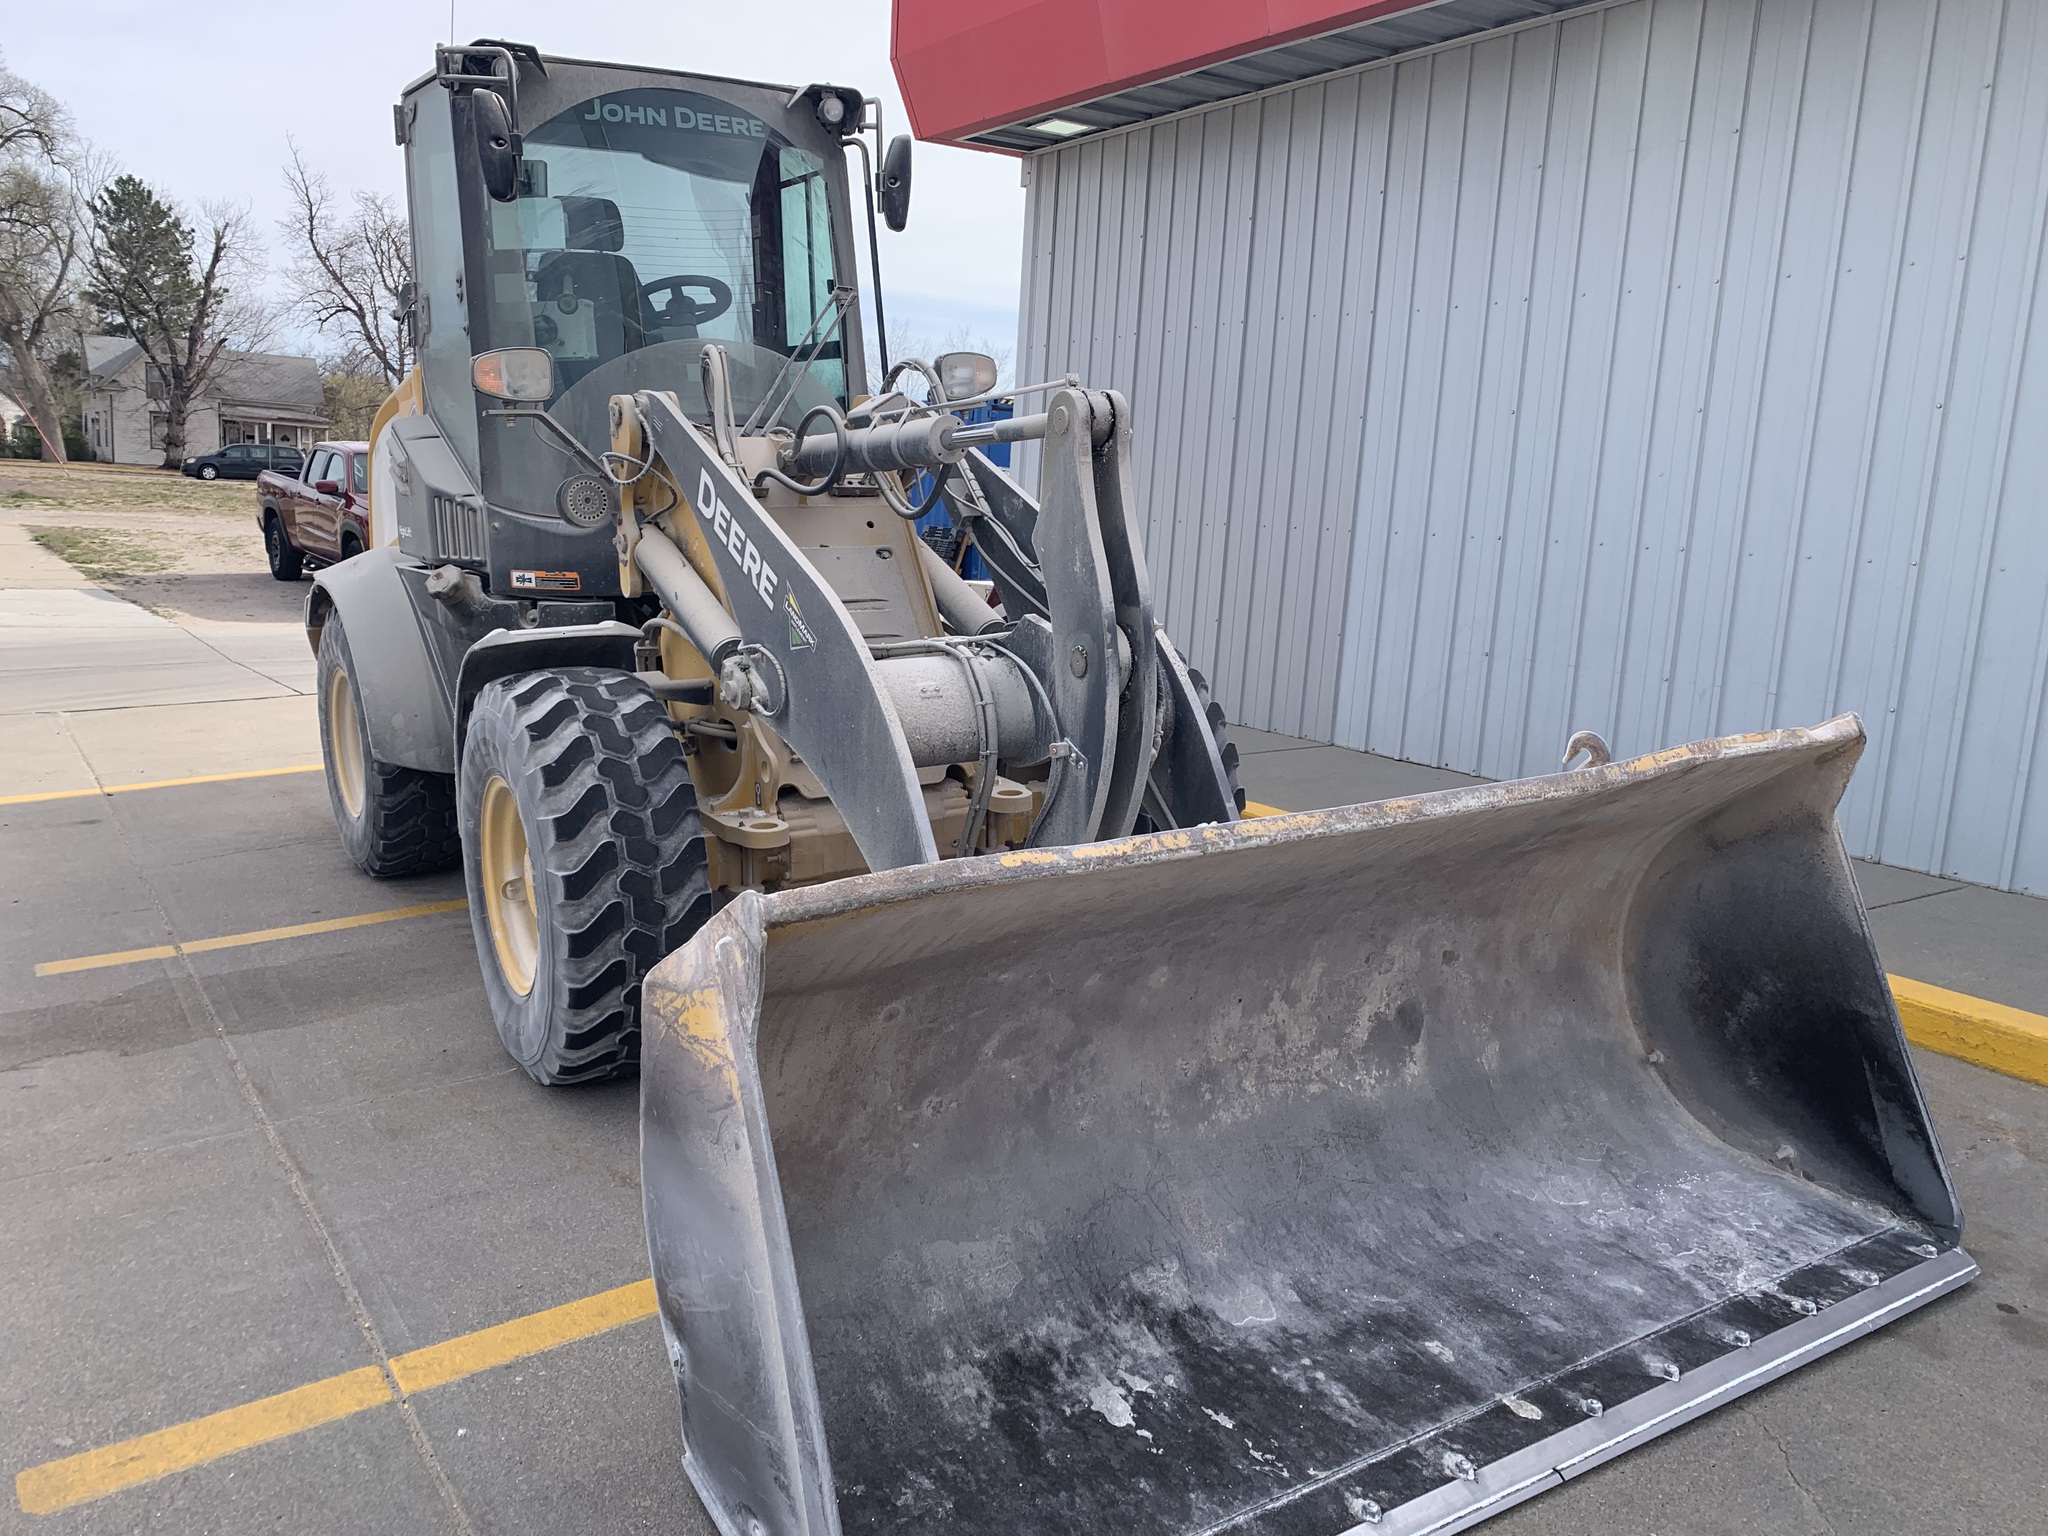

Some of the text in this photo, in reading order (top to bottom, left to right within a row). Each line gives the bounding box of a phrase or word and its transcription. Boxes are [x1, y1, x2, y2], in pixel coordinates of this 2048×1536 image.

[584, 98, 766, 138] JOHN DEERE
[697, 467, 778, 611] DEERE
[785, 600, 814, 647] LANDMARK
